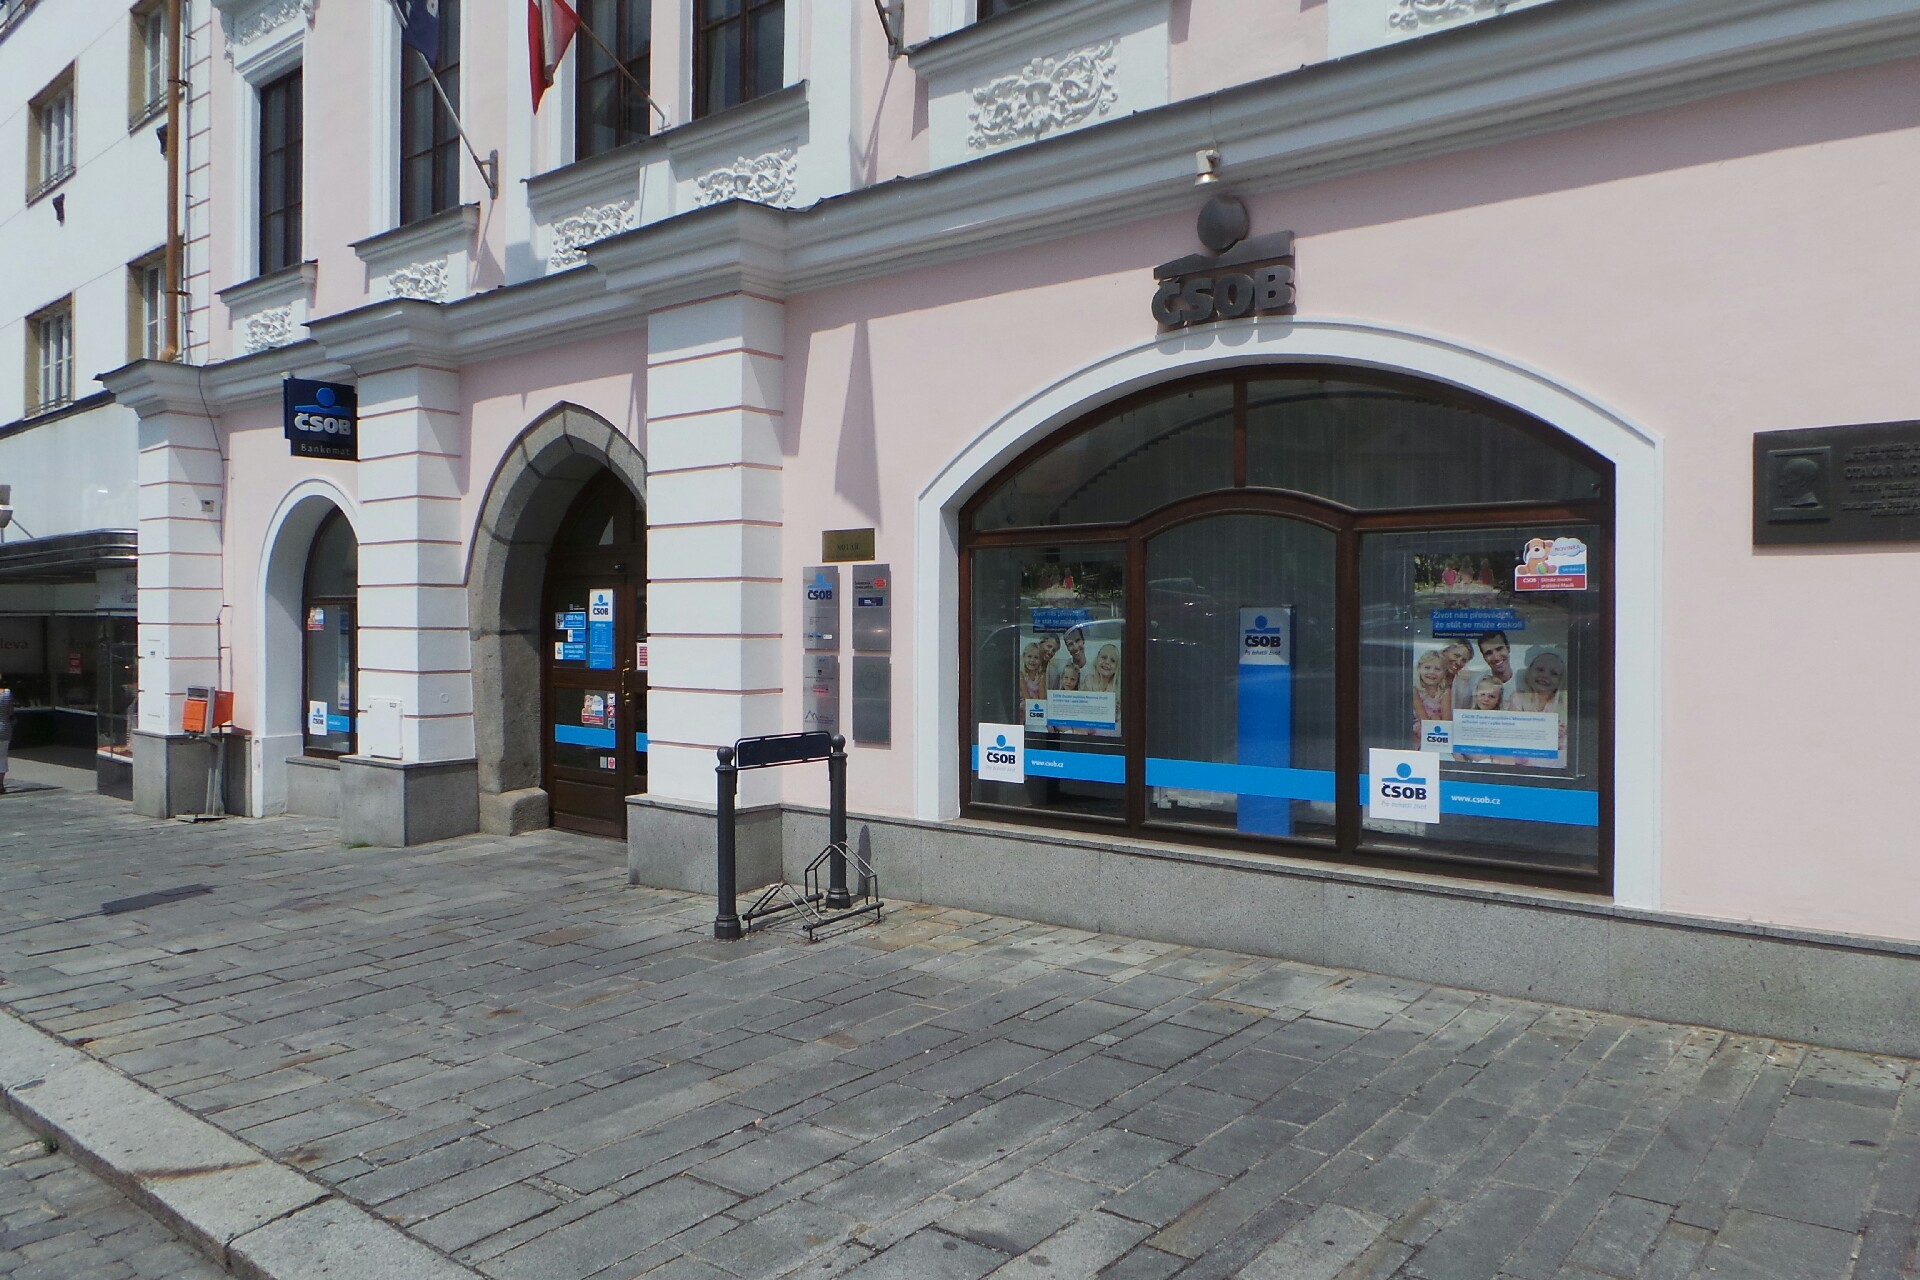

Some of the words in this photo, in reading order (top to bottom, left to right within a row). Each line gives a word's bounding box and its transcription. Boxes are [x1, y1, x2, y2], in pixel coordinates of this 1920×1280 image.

[1152, 265, 1296, 326] ČSOB
[294, 412, 351, 435] ČSOB
[301, 443, 351, 455] Bankomat
[1555, 544, 1580, 552] NOVINKA
[807, 589, 833, 600] ČSOB
[1433, 610, 1452, 619] Život
[1435, 620, 1445, 628] že
[1473, 620, 1495, 629] může
[1245, 634, 1281, 648] ČSOB
[1427, 735, 1448, 743] ČSOB
[986, 751, 1016, 764] ČSOB
[1031, 760, 1064, 768] www.csob.cz
[1381, 783, 1427, 800] ČSOB
[1451, 795, 1501, 805] www.csob.cz
